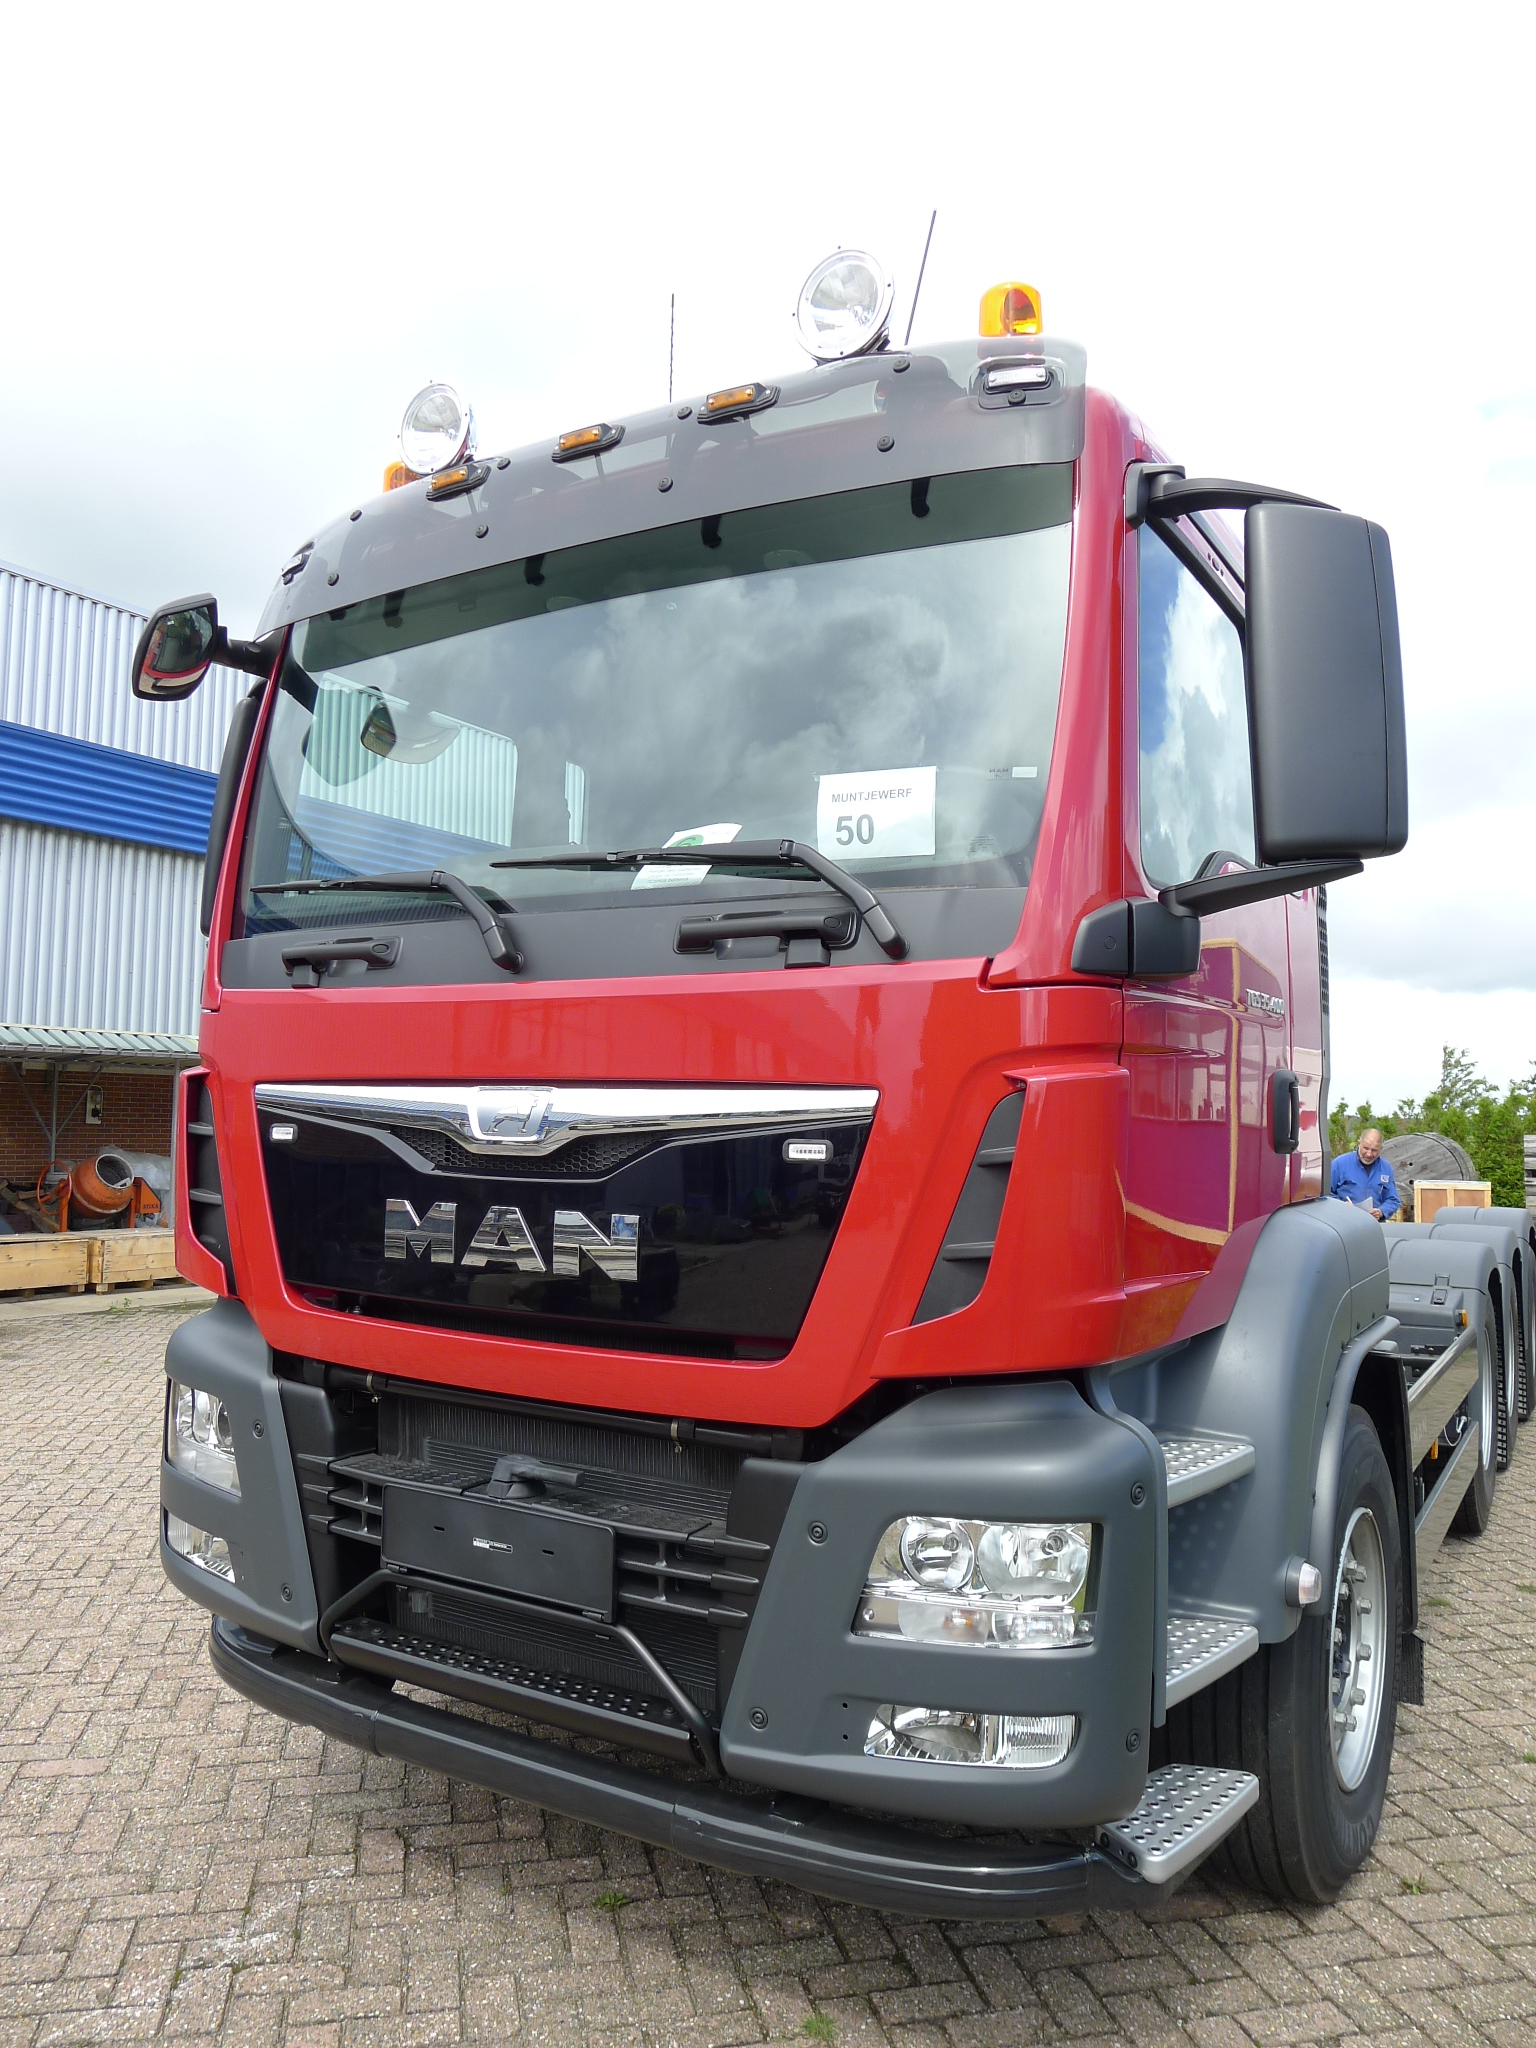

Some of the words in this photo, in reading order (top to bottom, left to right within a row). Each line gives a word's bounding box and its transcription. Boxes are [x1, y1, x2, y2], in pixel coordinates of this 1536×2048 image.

[831, 788, 912, 803] MUNTJEWERF
[836, 814, 874, 846] 50
[384, 1198, 641, 1282] MAN
